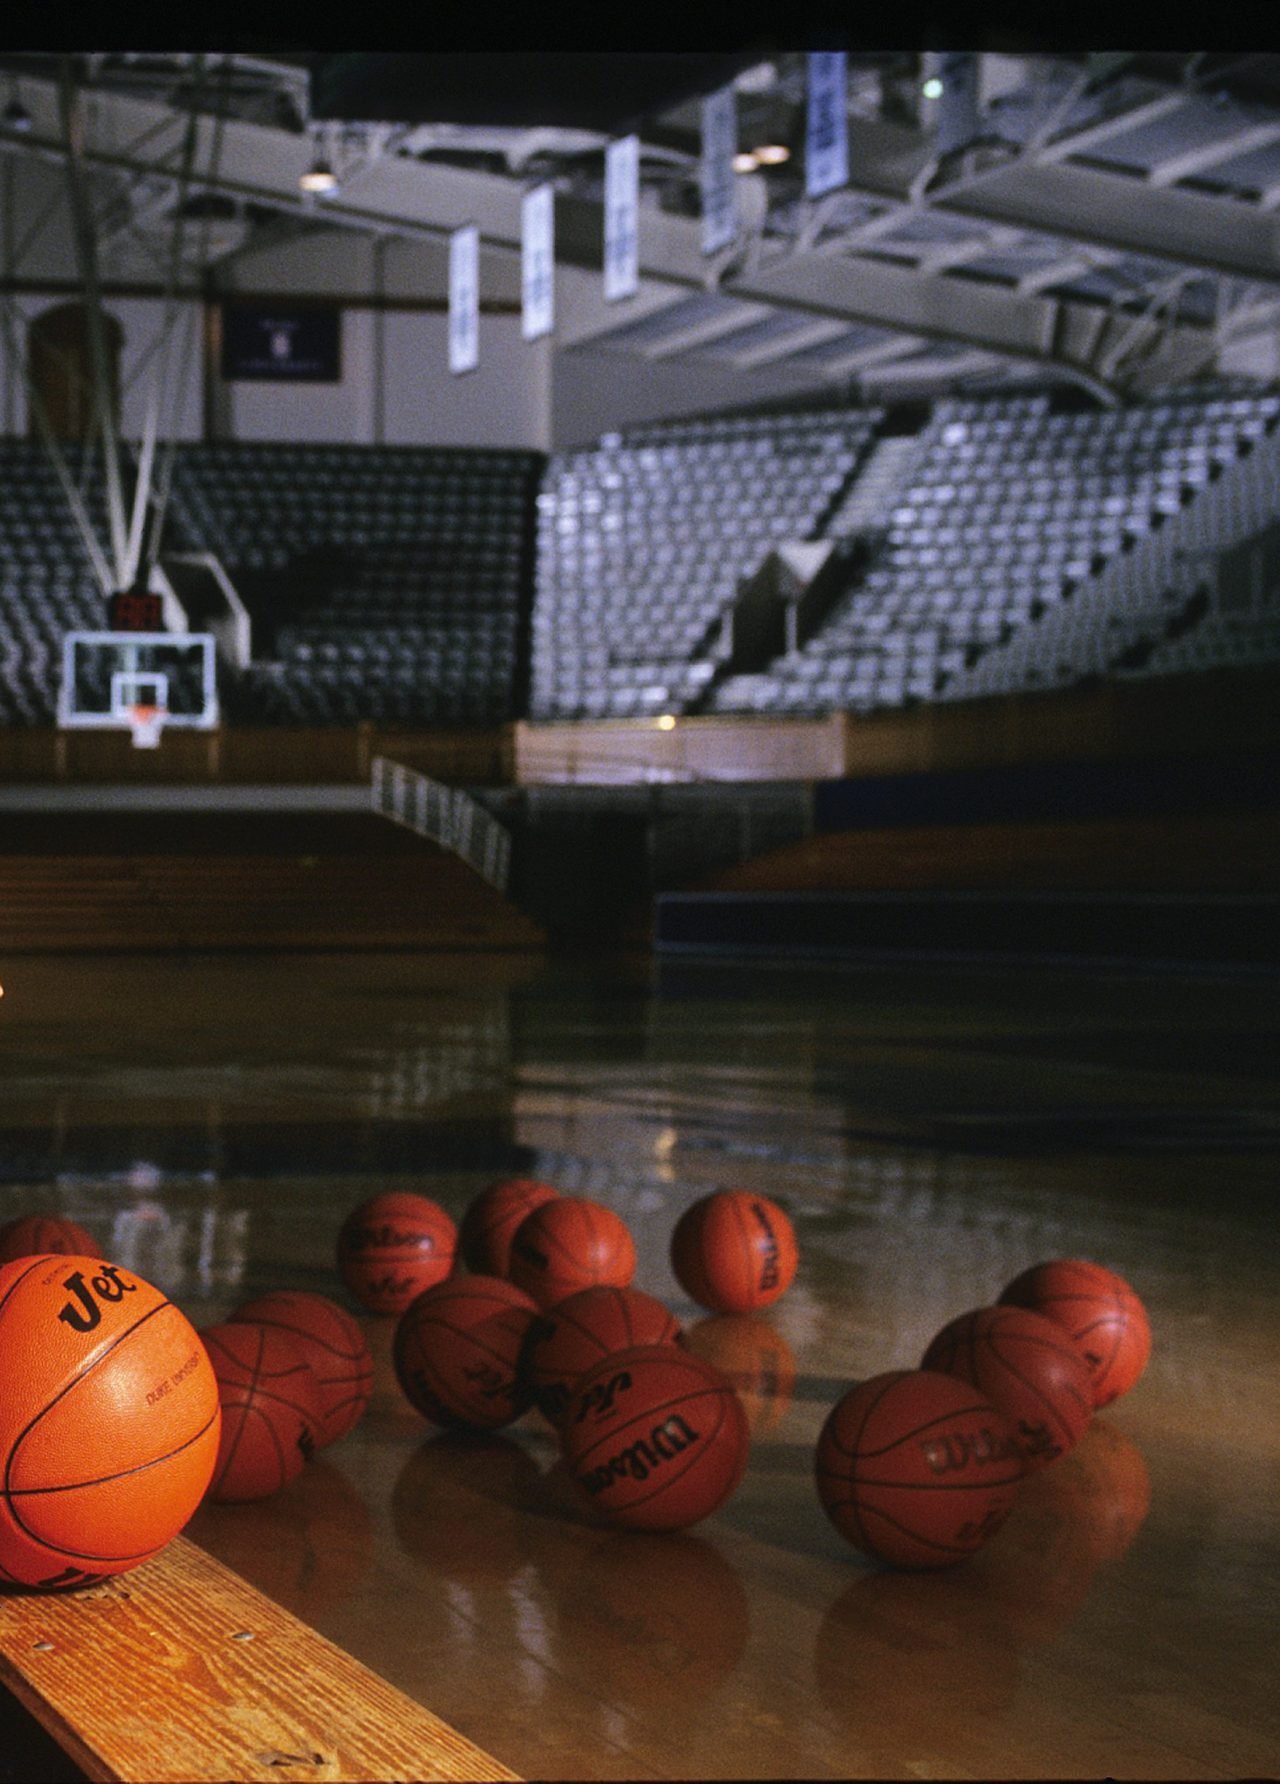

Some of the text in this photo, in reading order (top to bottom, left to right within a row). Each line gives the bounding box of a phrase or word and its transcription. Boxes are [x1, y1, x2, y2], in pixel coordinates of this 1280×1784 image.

[58, 1265, 137, 1333] Jet
[145, 1380, 172, 1406] DUKE
[578, 1415, 699, 1494] Wilson
